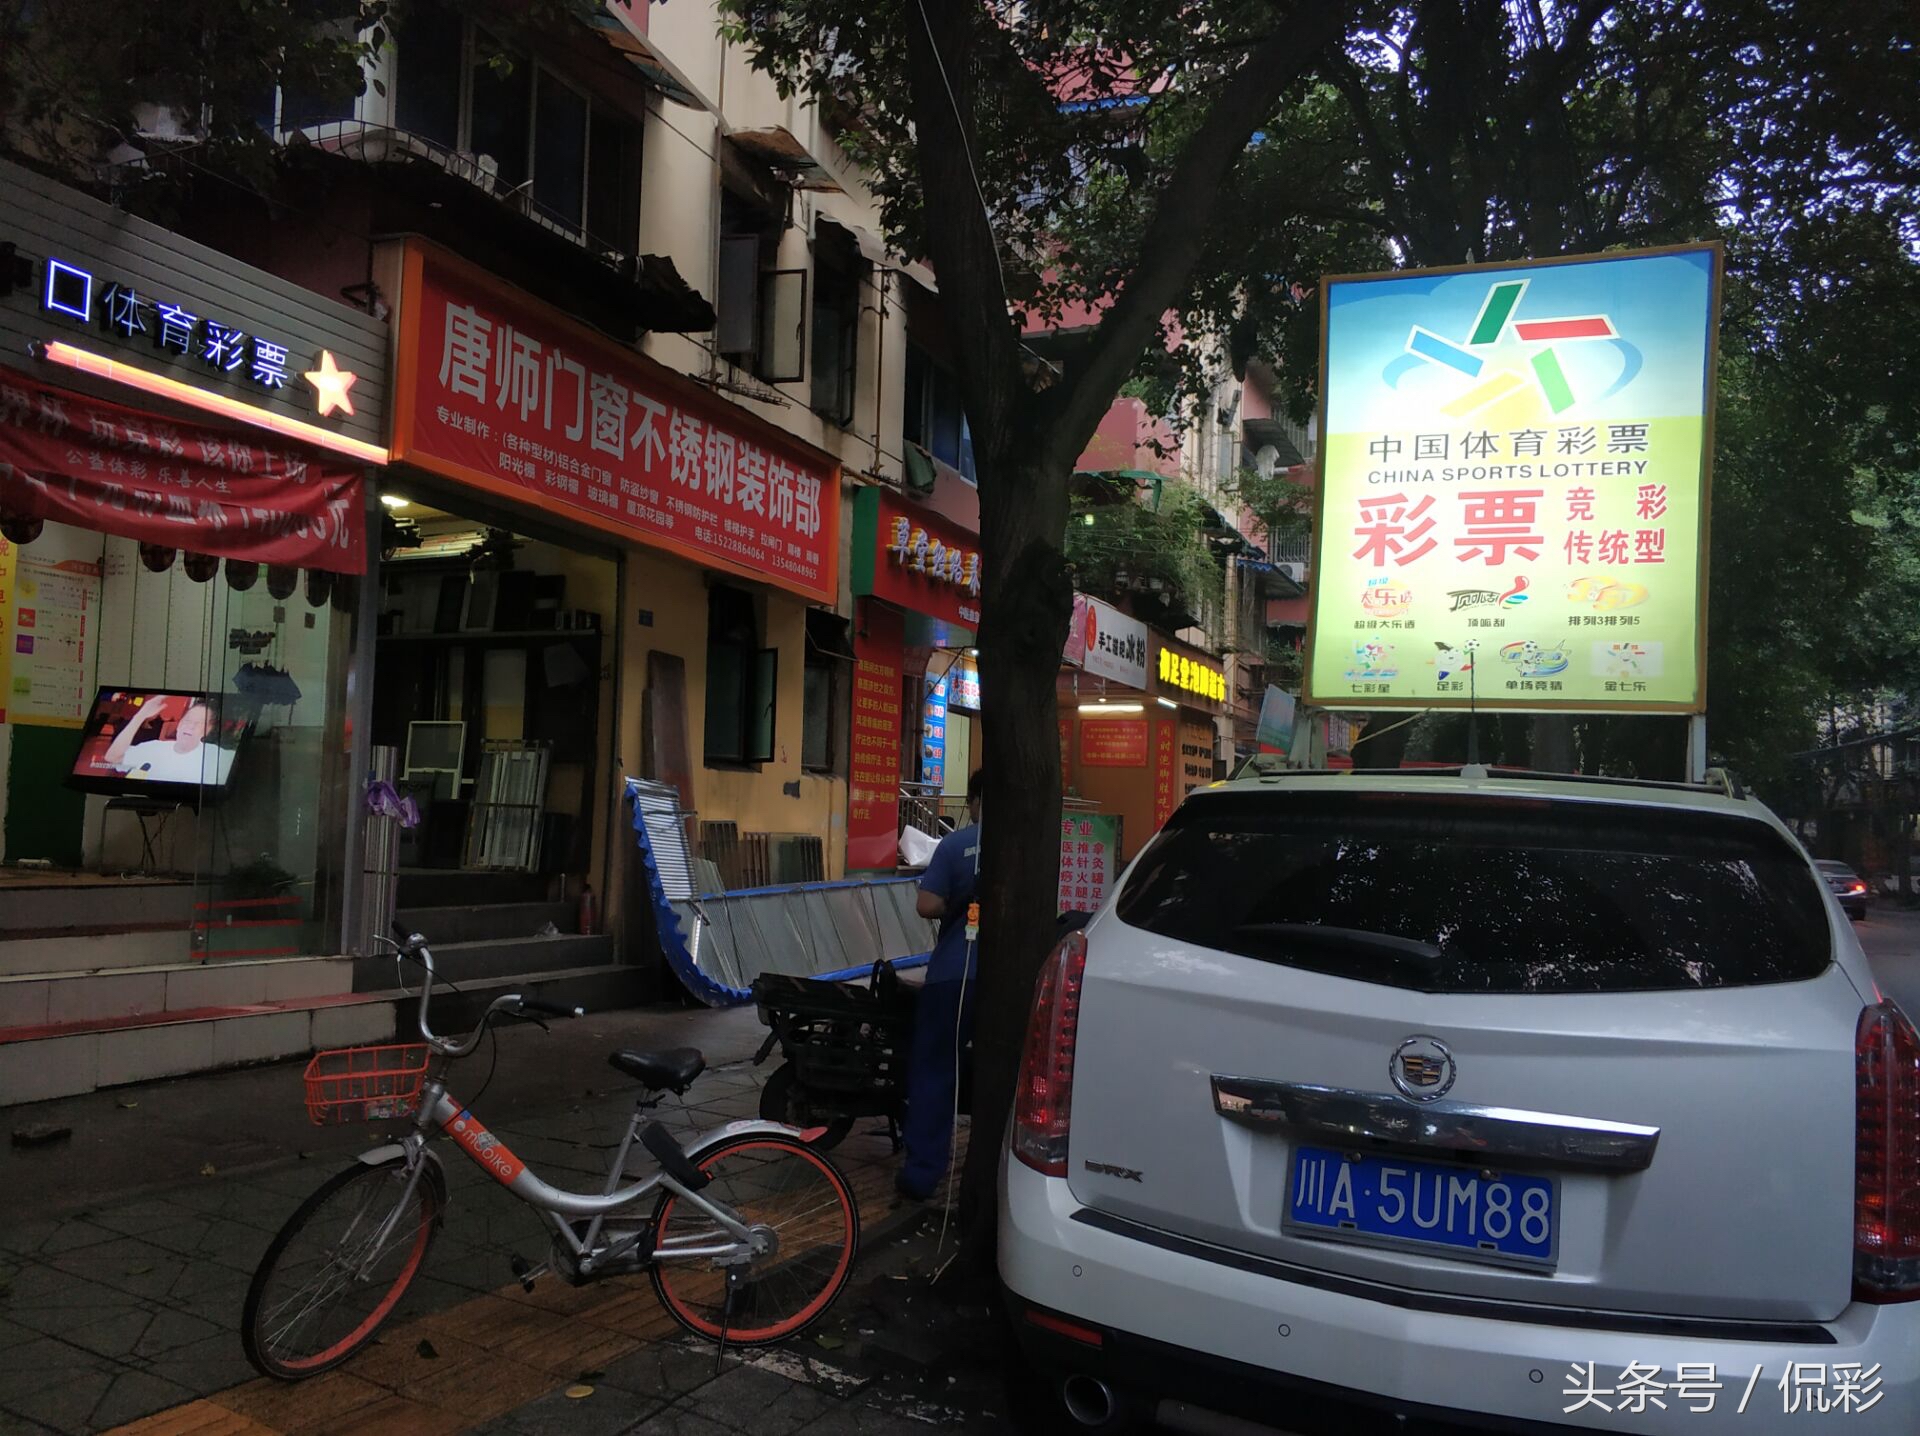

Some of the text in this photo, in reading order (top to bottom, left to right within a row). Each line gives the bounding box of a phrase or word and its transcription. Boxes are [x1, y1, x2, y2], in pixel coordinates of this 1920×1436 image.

[438, 301, 821, 539] 唐师门窗不锈钢装饰部
[1369, 424, 1649, 463] 中国体育彩票
[65, 450, 232, 494] 公益体彩 乐善人生
[1368, 460, 1648, 484] CHINA SPORTS LOTTERY
[1352, 489, 1544, 567] 彩票
[1563, 528, 1665, 565] 传统型
[1354, 620, 1416, 629] 超级大乐透
[1568, 615, 1641, 626] 排列3排列5
[1351, 680, 1647, 693] 七彩星 足彩 单场竞猜 金七乐
[1061, 819, 1092, 836] 专业
